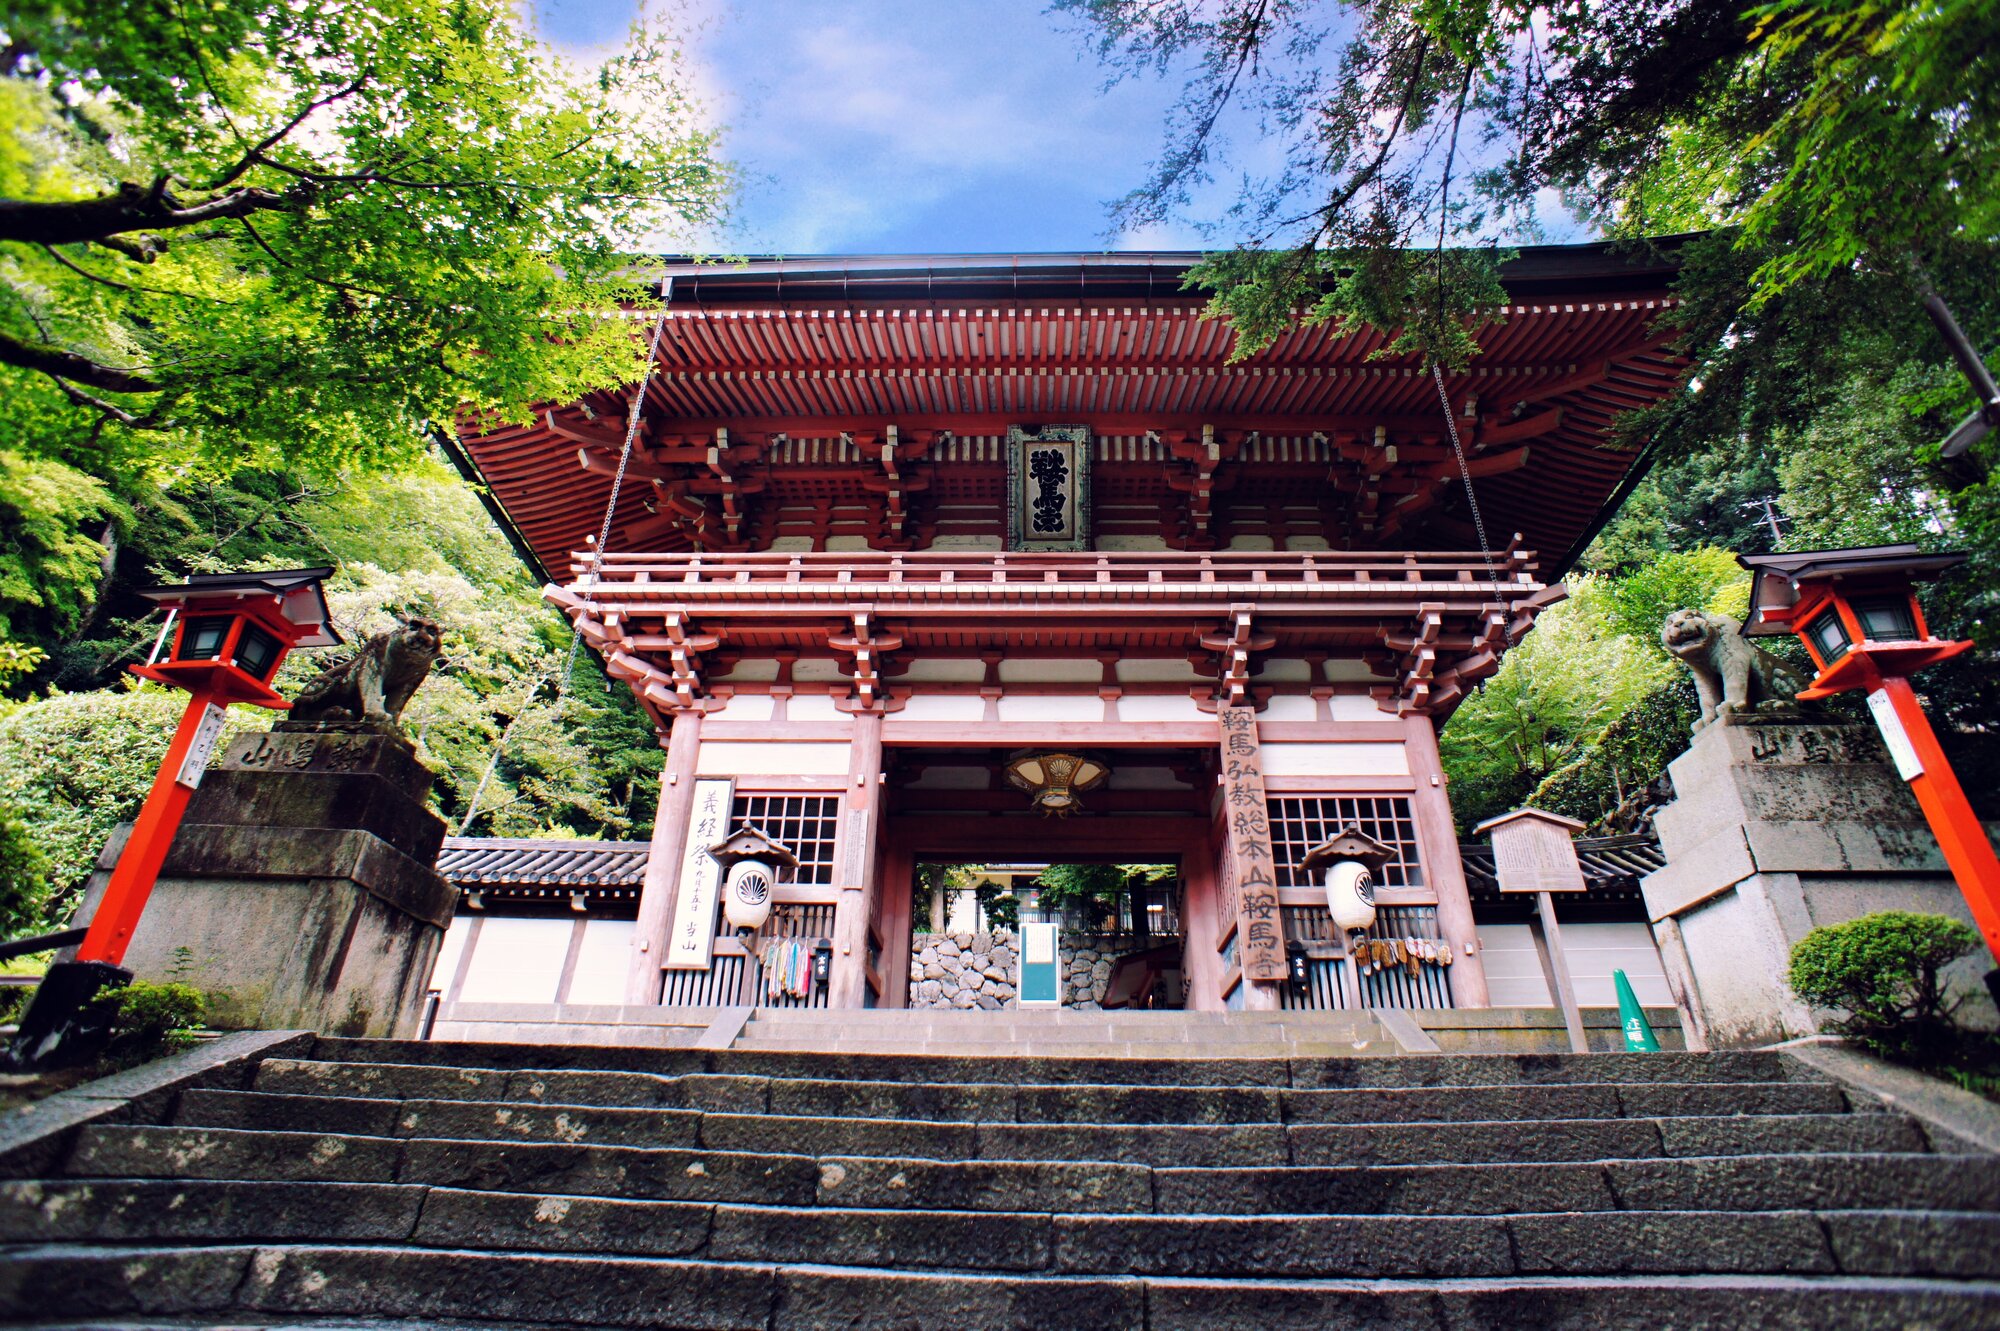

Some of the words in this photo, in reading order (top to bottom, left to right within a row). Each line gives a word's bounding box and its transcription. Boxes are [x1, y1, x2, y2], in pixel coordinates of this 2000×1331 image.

[690, 790, 720, 867] 義経祭
[1221, 709, 1284, 978] 鞍馬弘教総本山鞍馬寺
